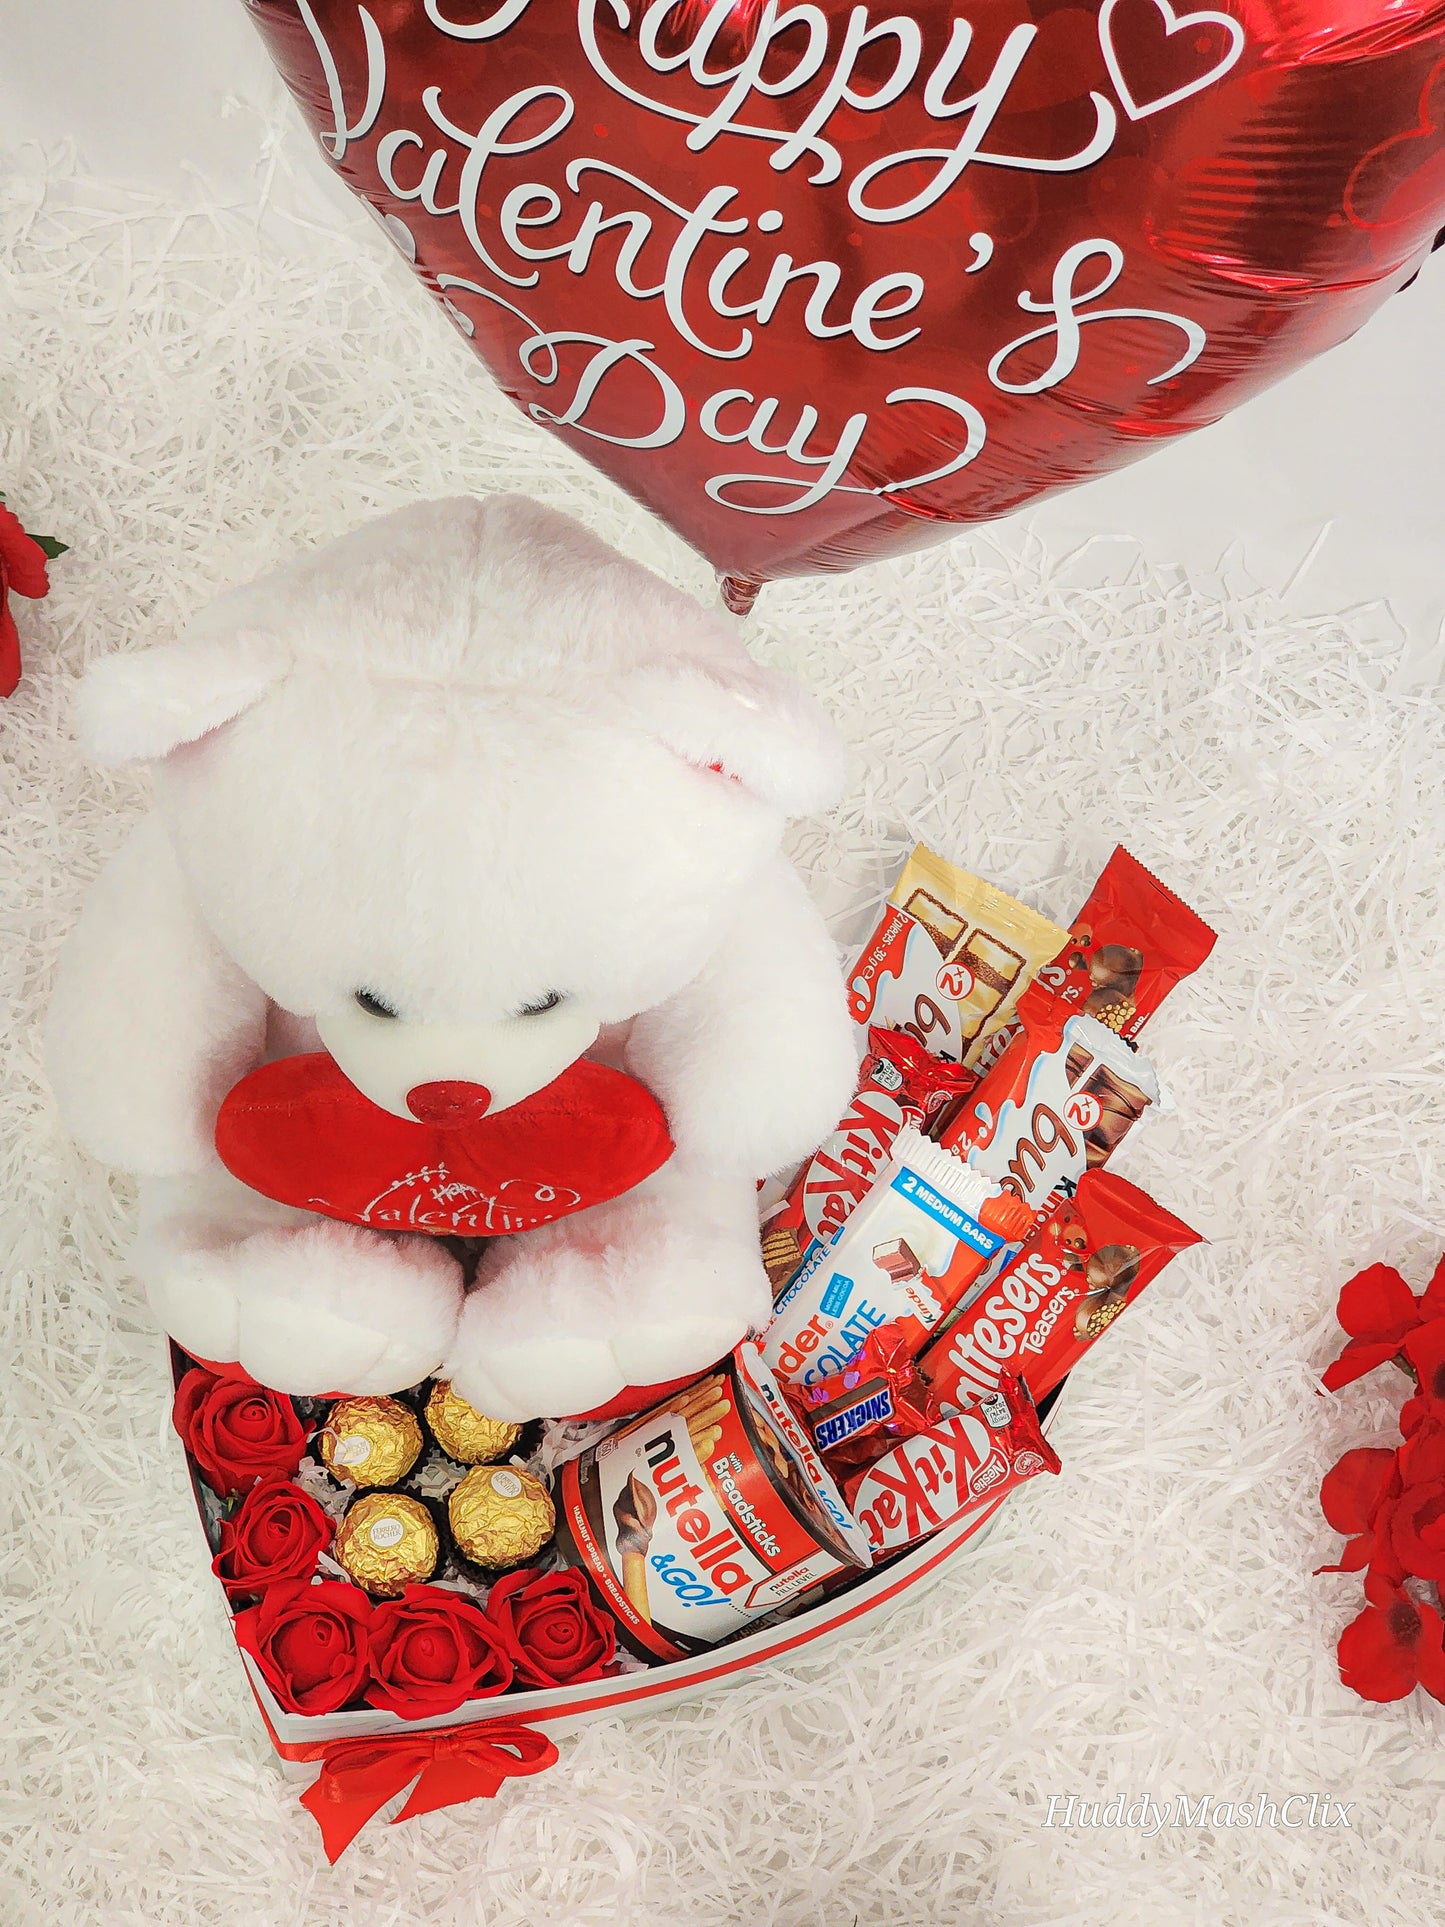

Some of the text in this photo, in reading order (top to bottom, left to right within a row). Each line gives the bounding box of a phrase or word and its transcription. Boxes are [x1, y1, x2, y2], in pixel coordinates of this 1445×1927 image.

[437, 274, 987, 514] Day
[872, 946, 888, 961] 39
[881, 917, 902, 946] pieces
[902, 1176, 995, 1250] 2 MEDIUM BARS
[774, 1246, 831, 1315] CHOCOLATE
[1019, 1286, 1075, 1355] Teasers
[761, 1384, 823, 1484] nutella
[815, 1389, 892, 1450] SNICKERS
[728, 1451, 743, 1474] with
[858, 1417, 982, 1547] KitKat
[645, 1429, 753, 1595] nutella
[712, 1457, 781, 1558] Breadsticks
[572, 1505, 591, 1544] HAZELNUT
[585, 1541, 605, 1573] SPREAD
[604, 1578, 640, 1626] BREADSTICKS
[651, 1554, 731, 1608] &GO!
[769, 1567, 810, 1592] nutella
[775, 1572, 817, 1597] FILL LEVEL
